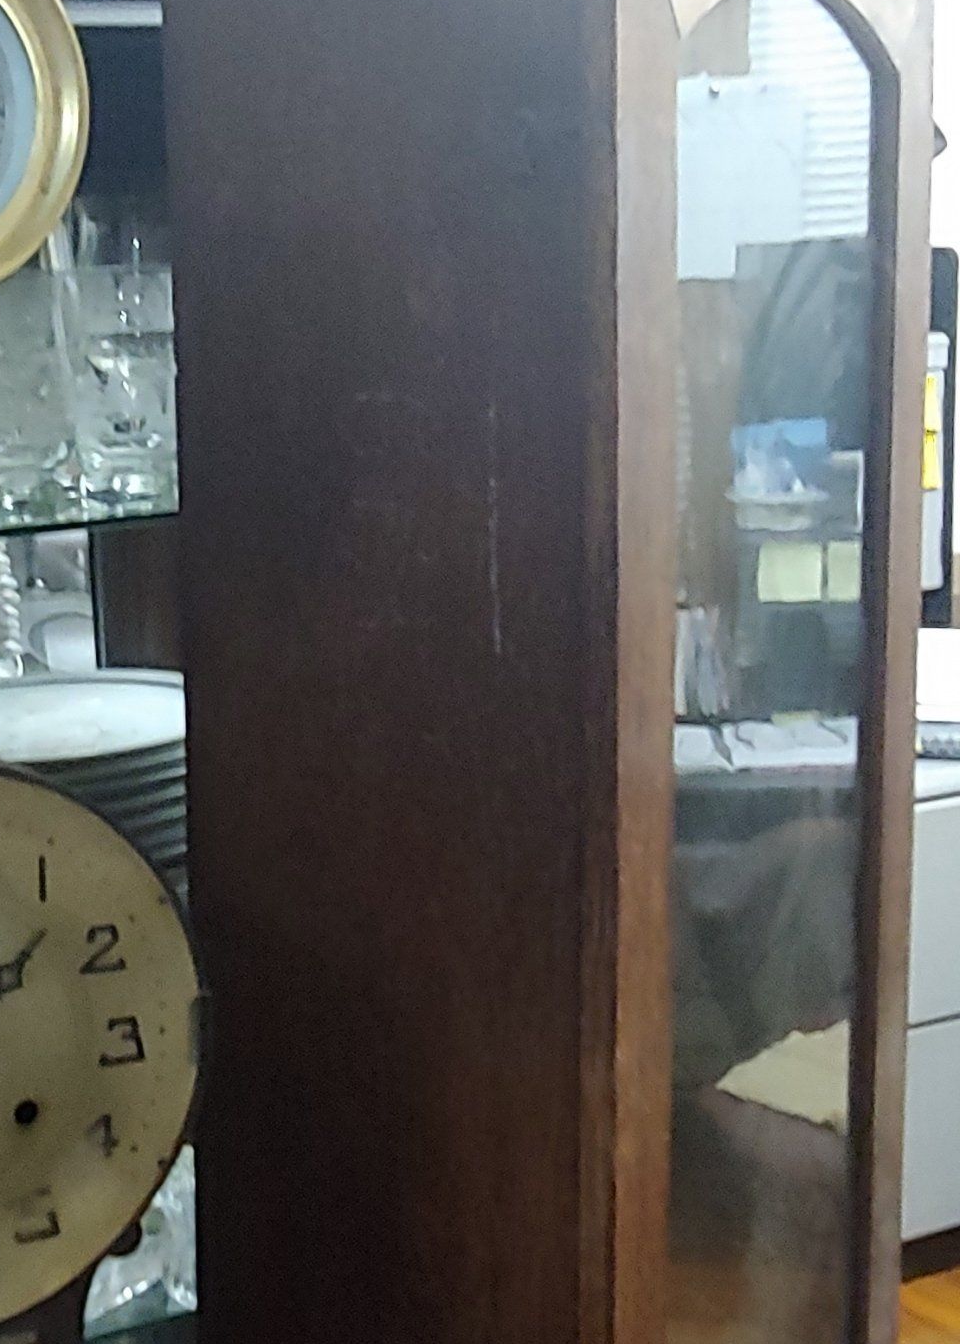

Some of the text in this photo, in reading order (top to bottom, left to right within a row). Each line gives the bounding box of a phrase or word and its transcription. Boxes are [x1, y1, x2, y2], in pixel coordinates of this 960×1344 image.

[37, 854, 48, 904] 1
[78, 923, 128, 975] 2
[97, 1014, 146, 1068] 3
[85, 1112, 121, 1158] 4
